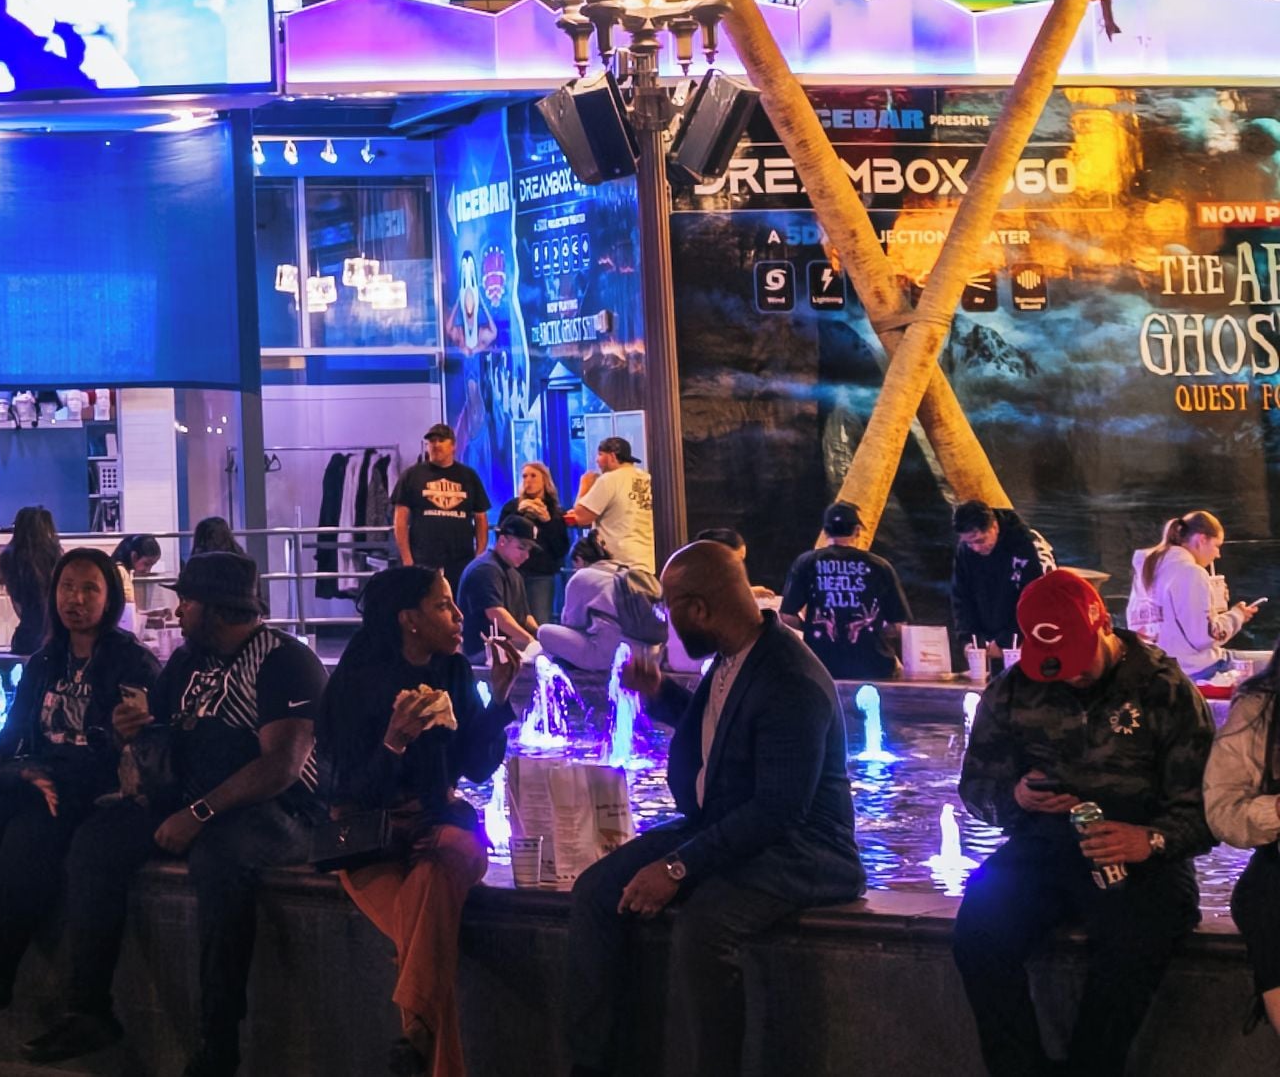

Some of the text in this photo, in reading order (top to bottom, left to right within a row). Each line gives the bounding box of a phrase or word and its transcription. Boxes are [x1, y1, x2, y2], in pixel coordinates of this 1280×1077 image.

[816, 108, 990, 130] CEBAR PRESENTS
[520, 167, 572, 202] DREAMBOX
[694, 157, 969, 195] REMBOX
[456, 181, 510, 223] ICEBAR
[1200, 206, 1256, 223] NOW
[767, 230, 781, 244] A
[1157, 254, 1225, 295] THE
[1175, 384, 1250, 412] QUEST
[824, 592, 861, 608] ALL
[1031, 622, 1064, 644] C
